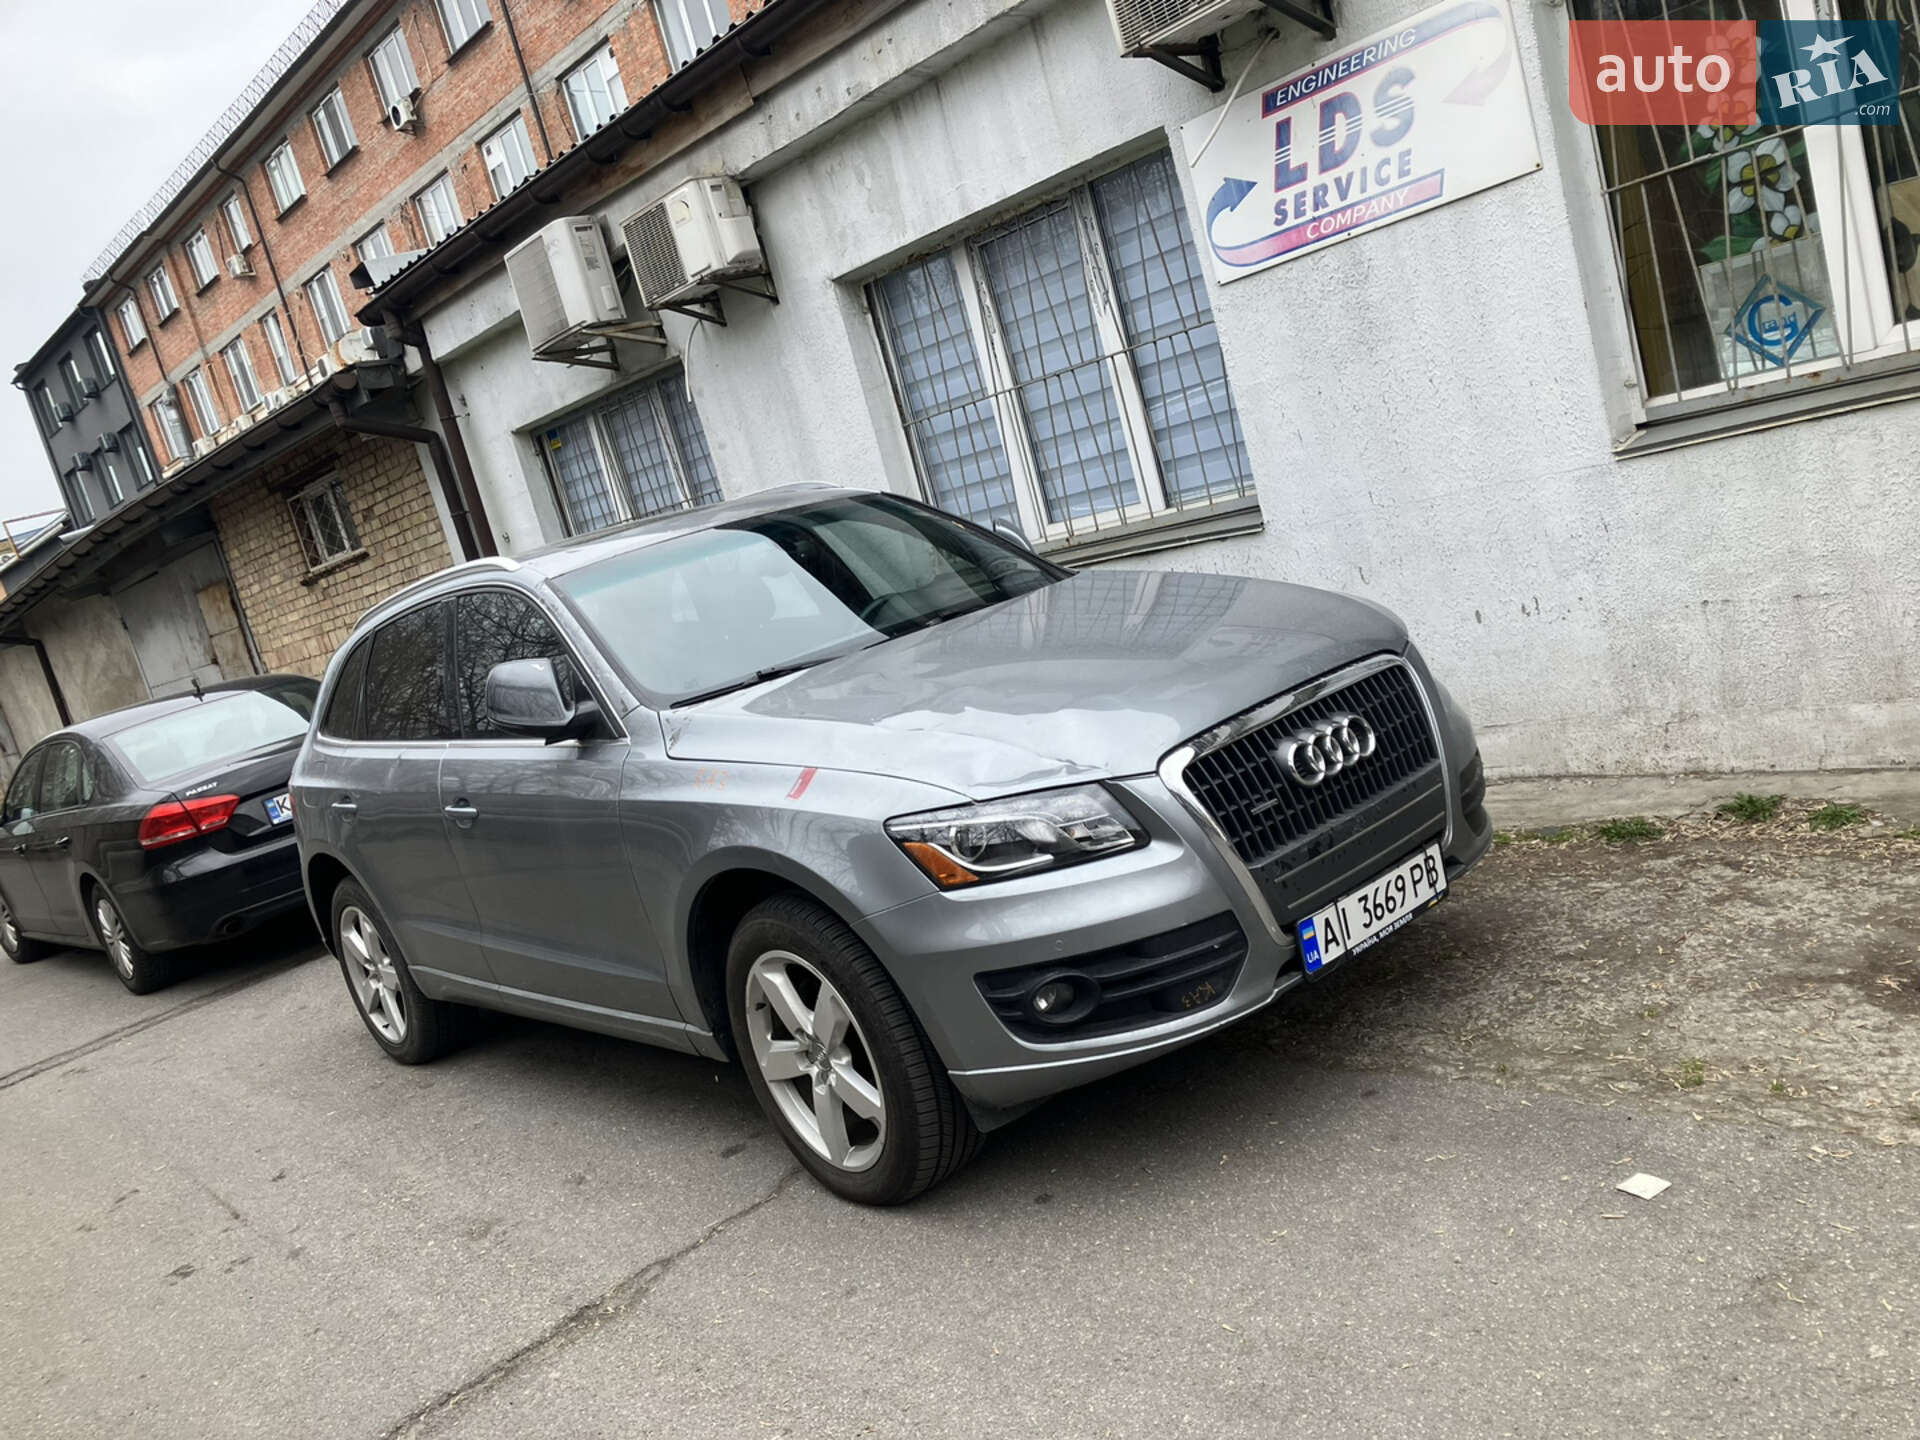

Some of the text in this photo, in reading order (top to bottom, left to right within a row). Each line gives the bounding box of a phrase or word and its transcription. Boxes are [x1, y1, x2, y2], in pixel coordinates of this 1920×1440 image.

[1276, 28, 1416, 107] ENGINEERING
[1273, 66, 1416, 194] LDS
[1273, 148, 1413, 227] SERVICE
[1306, 188, 1411, 239] COMPANY
[1324, 854, 1439, 954] AI 3669 PB
[1306, 949, 1320, 964] UA
